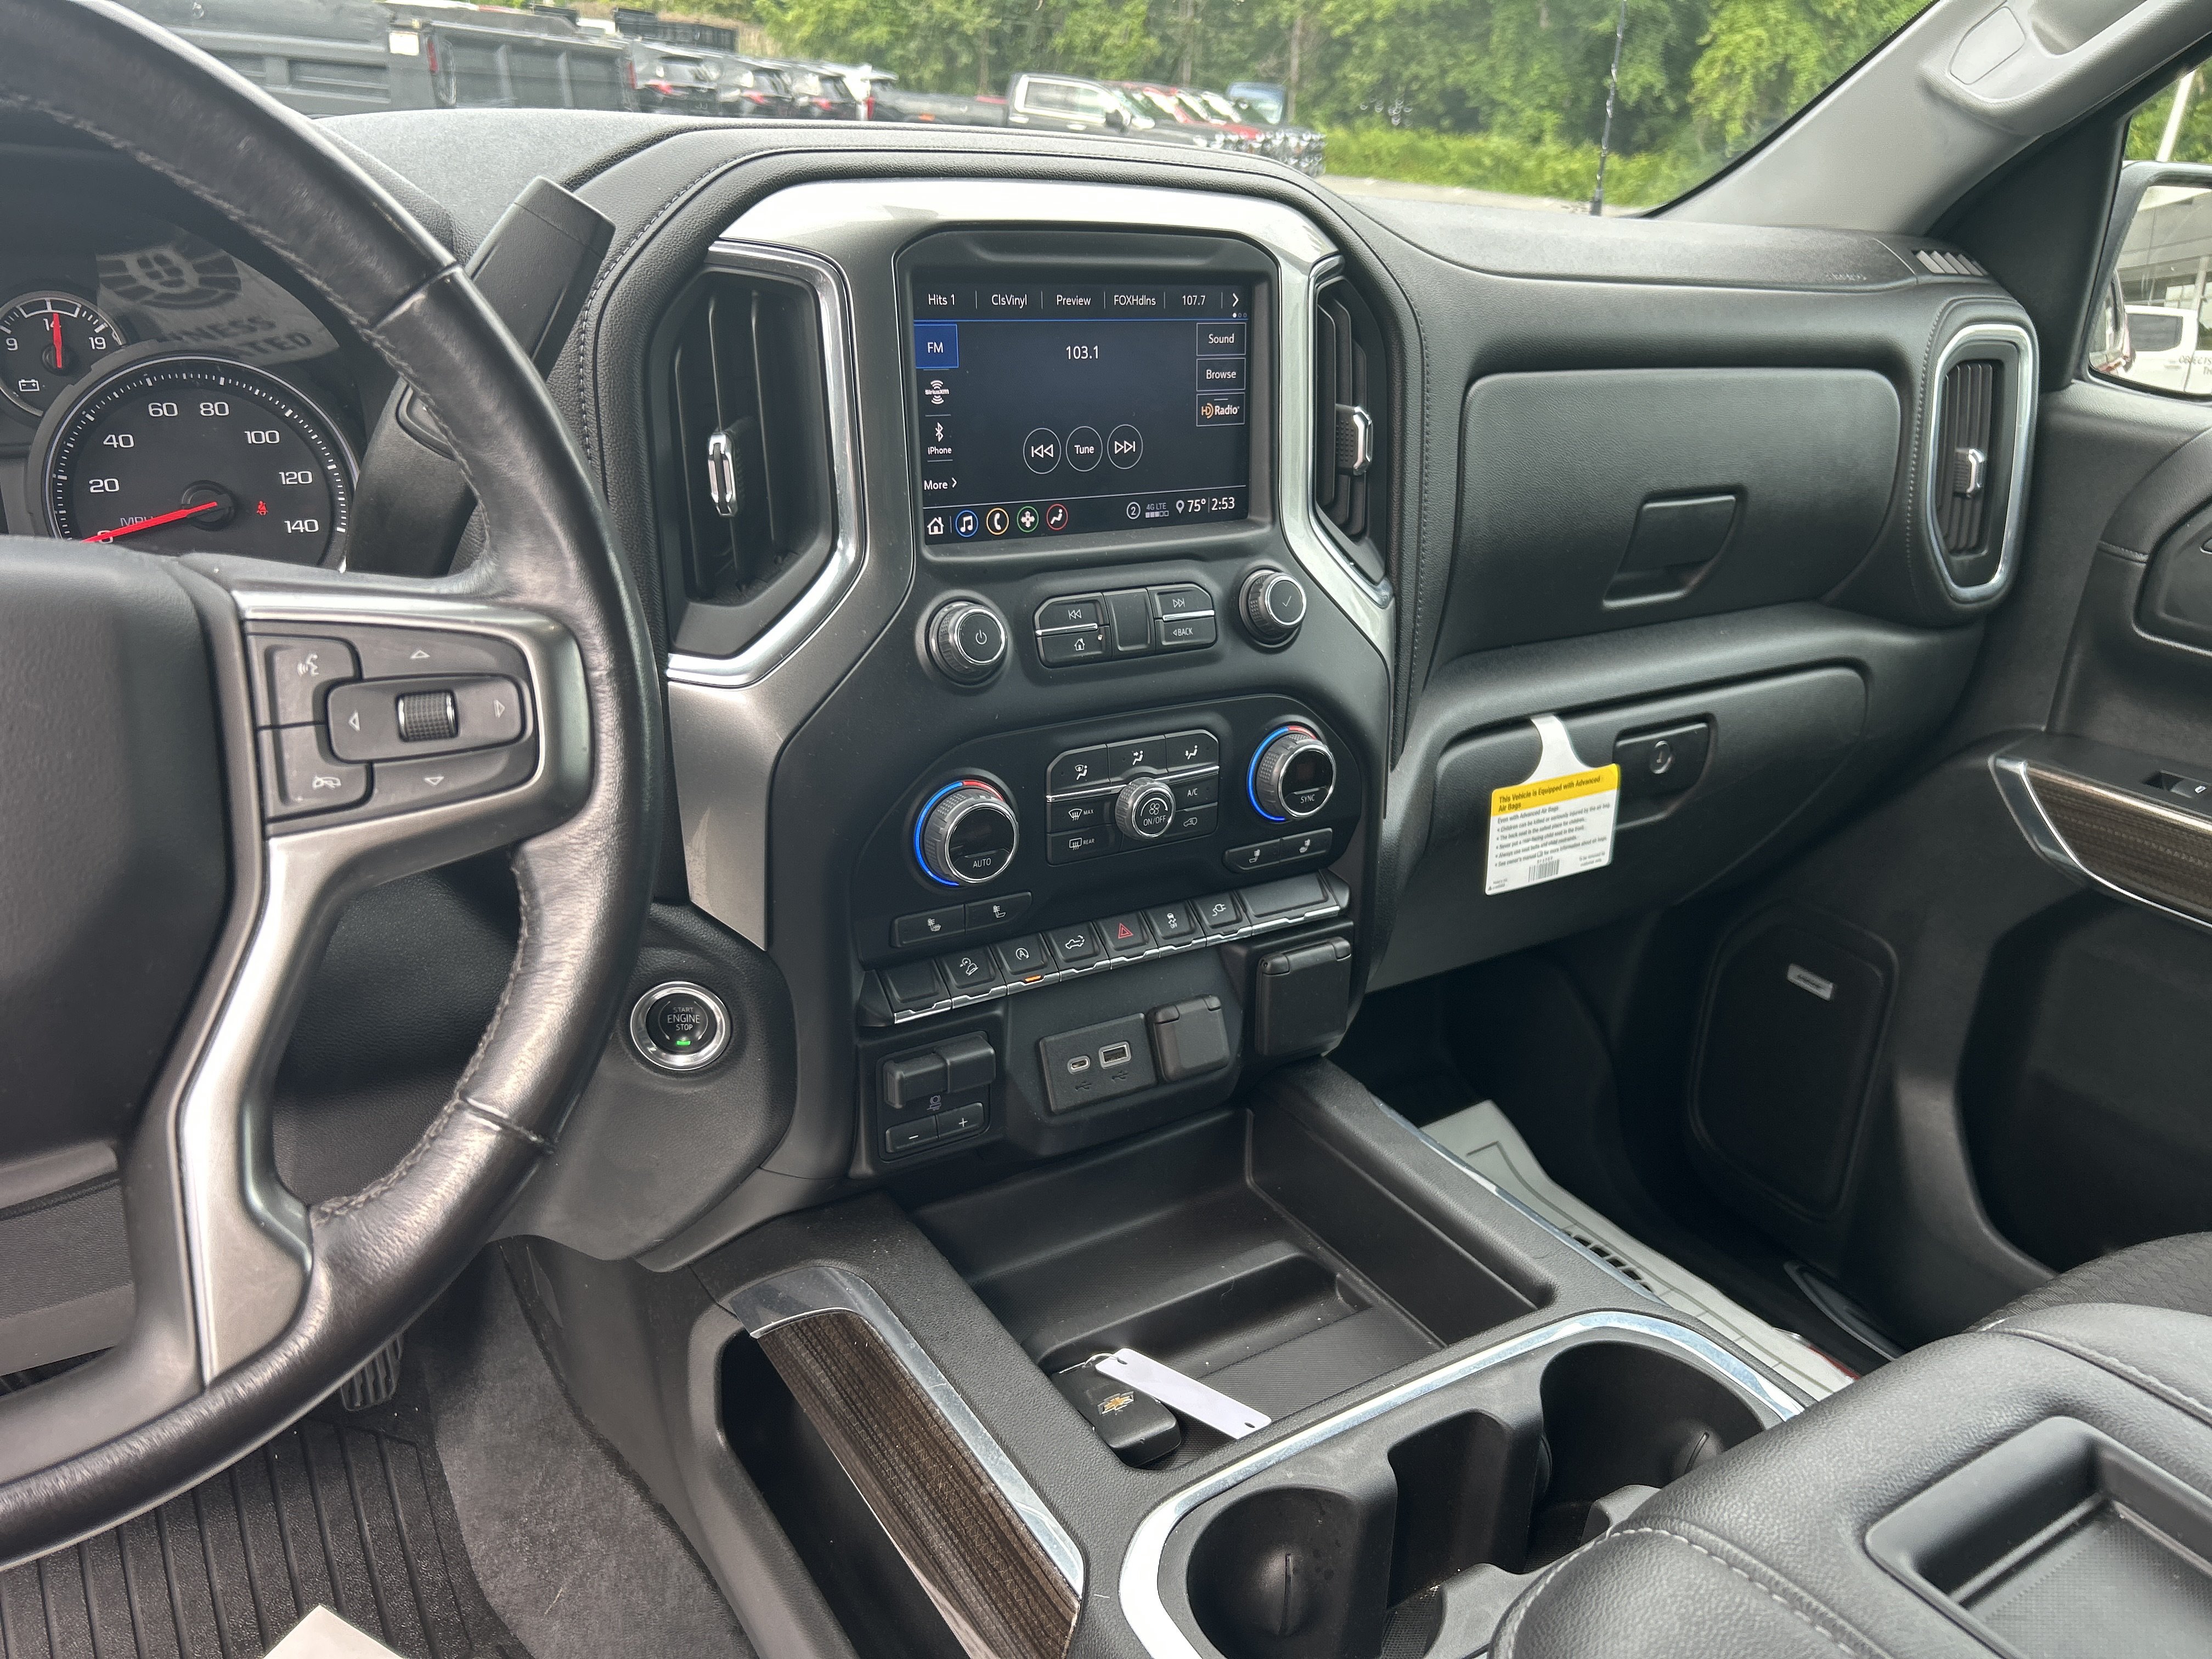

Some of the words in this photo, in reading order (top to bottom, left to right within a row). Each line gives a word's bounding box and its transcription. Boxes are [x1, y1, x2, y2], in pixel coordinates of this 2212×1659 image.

[928, 293, 948, 306] Hits
[950, 294, 956, 306] 1
[991, 294, 1028, 309] ClsVinyl
[1056, 294, 1091, 306] Preview
[1114, 295, 1156, 306] FOXHdlns
[1182, 295, 1206, 306] 107.7
[6, 337, 18, 351] 9
[89, 336, 106, 349] 19
[1208, 333, 1235, 344] Sound
[927, 342, 944, 353] FM
[1066, 345, 1099, 360] 103.1
[1206, 369, 1237, 380] Browse
[148, 402, 178, 417] 60
[200, 402, 229, 416] 80
[103, 434, 134, 448] 40
[244, 430, 280, 444] 100
[927, 446, 952, 455] iPhone
[1074, 444, 1094, 454] Tune
[279, 471, 313, 485] 120
[89, 478, 120, 493] 20
[923, 480, 948, 490] More
[1211, 496, 1235, 511] 2:53
[284, 520, 319, 533] 140
[1177, 627, 1193, 636] BACK
[1187, 787, 1198, 797] A/C
[1499, 795, 1511, 804] This
[1512, 791, 1531, 801] Vehicle
[1538, 783, 1562, 795] Equipped
[1562, 781, 1575, 789] with
[1575, 775, 1601, 787] Advanced
[1300, 794, 1316, 804] SYNC
[1498, 804, 1507, 812] Air
[1508, 802, 1522, 810] Bags
[1143, 815, 1167, 827] ON/OFF
[973, 857, 992, 869] AUTO
[667, 1014, 700, 1024] ENGINE
